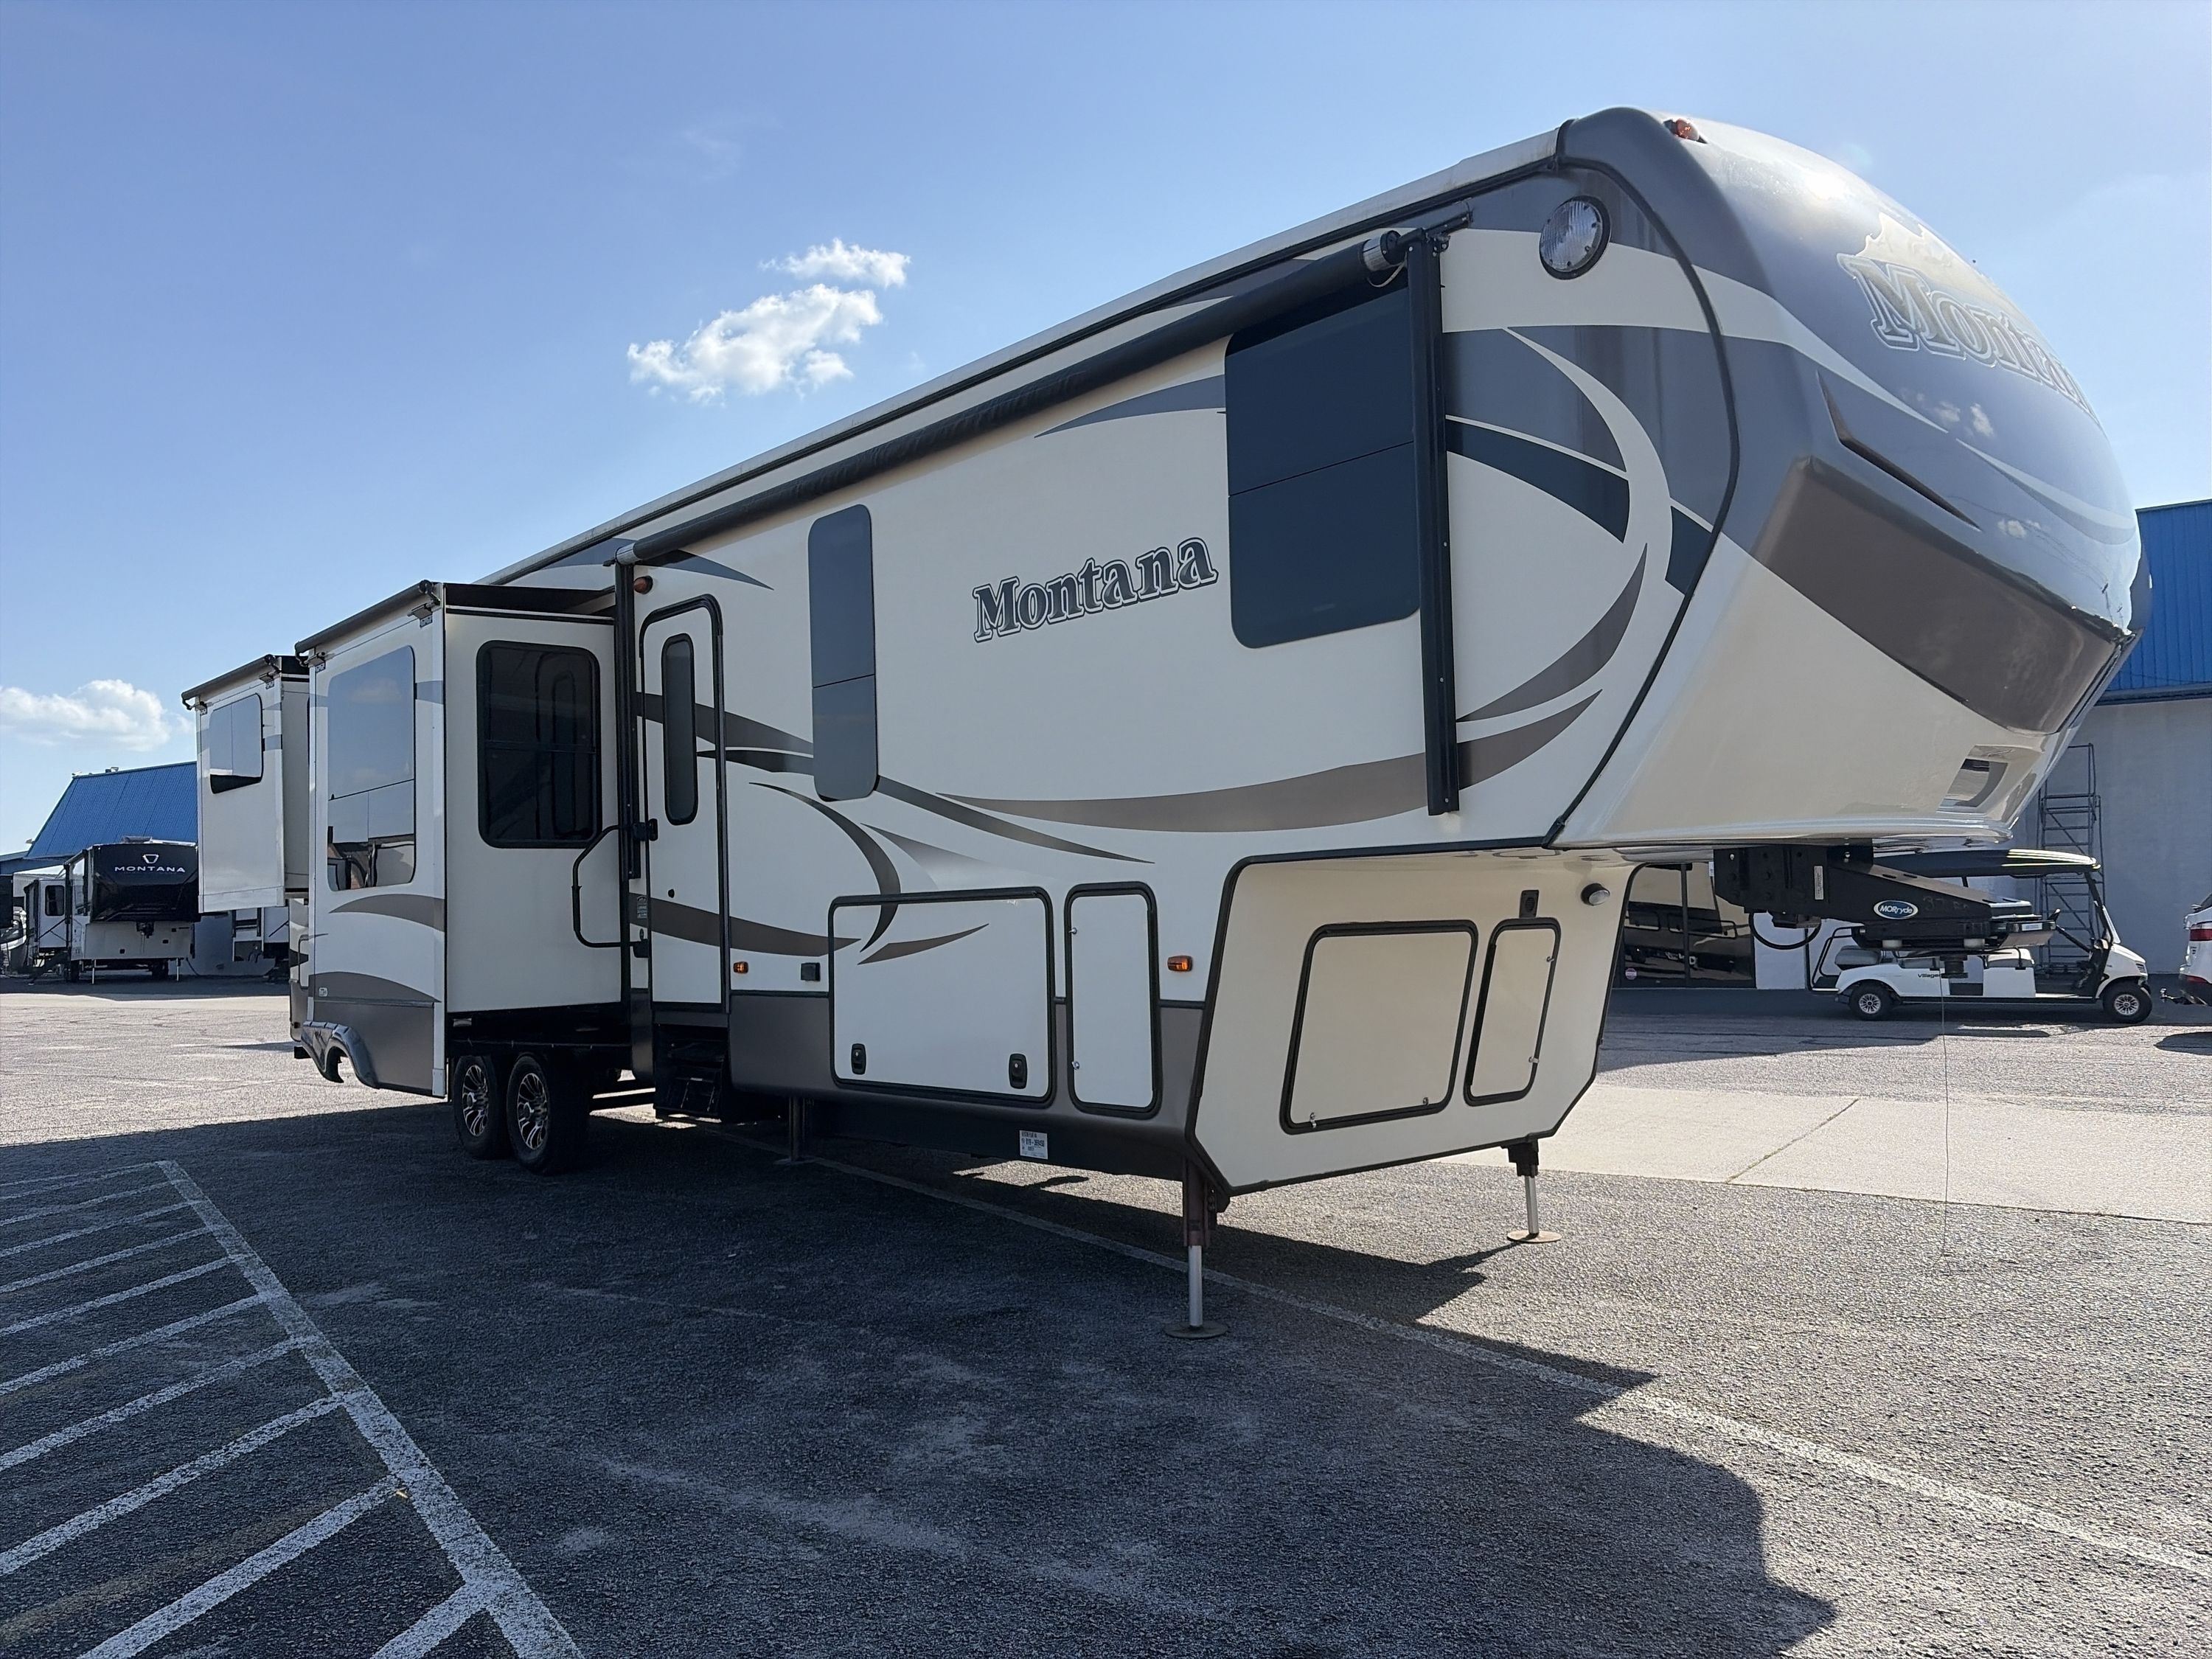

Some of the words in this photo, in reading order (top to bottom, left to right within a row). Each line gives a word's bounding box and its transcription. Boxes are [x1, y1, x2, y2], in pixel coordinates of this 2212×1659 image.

[1837, 252, 2101, 429] Montan
[973, 537, 1219, 643] Montana
[1879, 905, 1913, 914] MORryde
